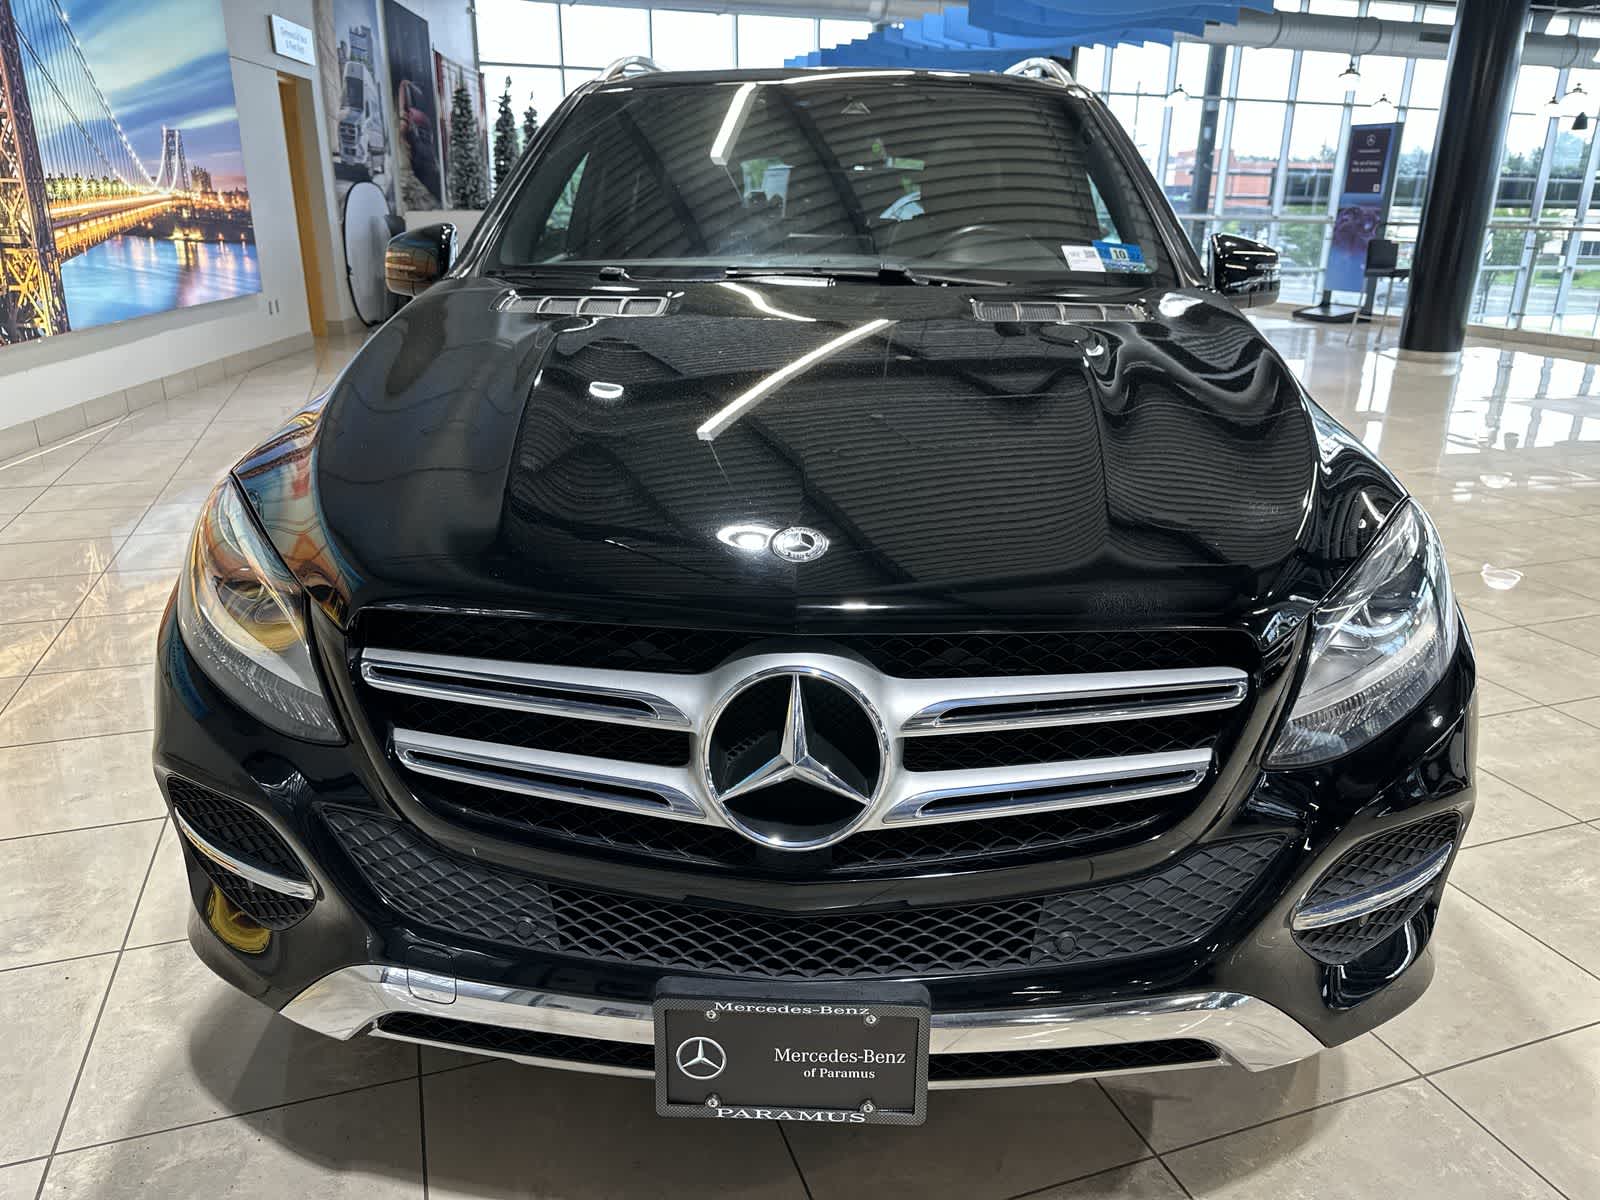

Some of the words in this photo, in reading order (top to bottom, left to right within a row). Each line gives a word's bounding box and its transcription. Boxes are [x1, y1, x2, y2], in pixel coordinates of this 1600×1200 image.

[1113, 249, 1126, 260] 10
[714, 1002, 870, 1016] Mercedes-Benz
[773, 1048, 906, 1064] Mercedes-Benz
[803, 1068, 817, 1079] of
[819, 1068, 876, 1080] Paramus
[716, 1108, 866, 1123] PARAMUS
